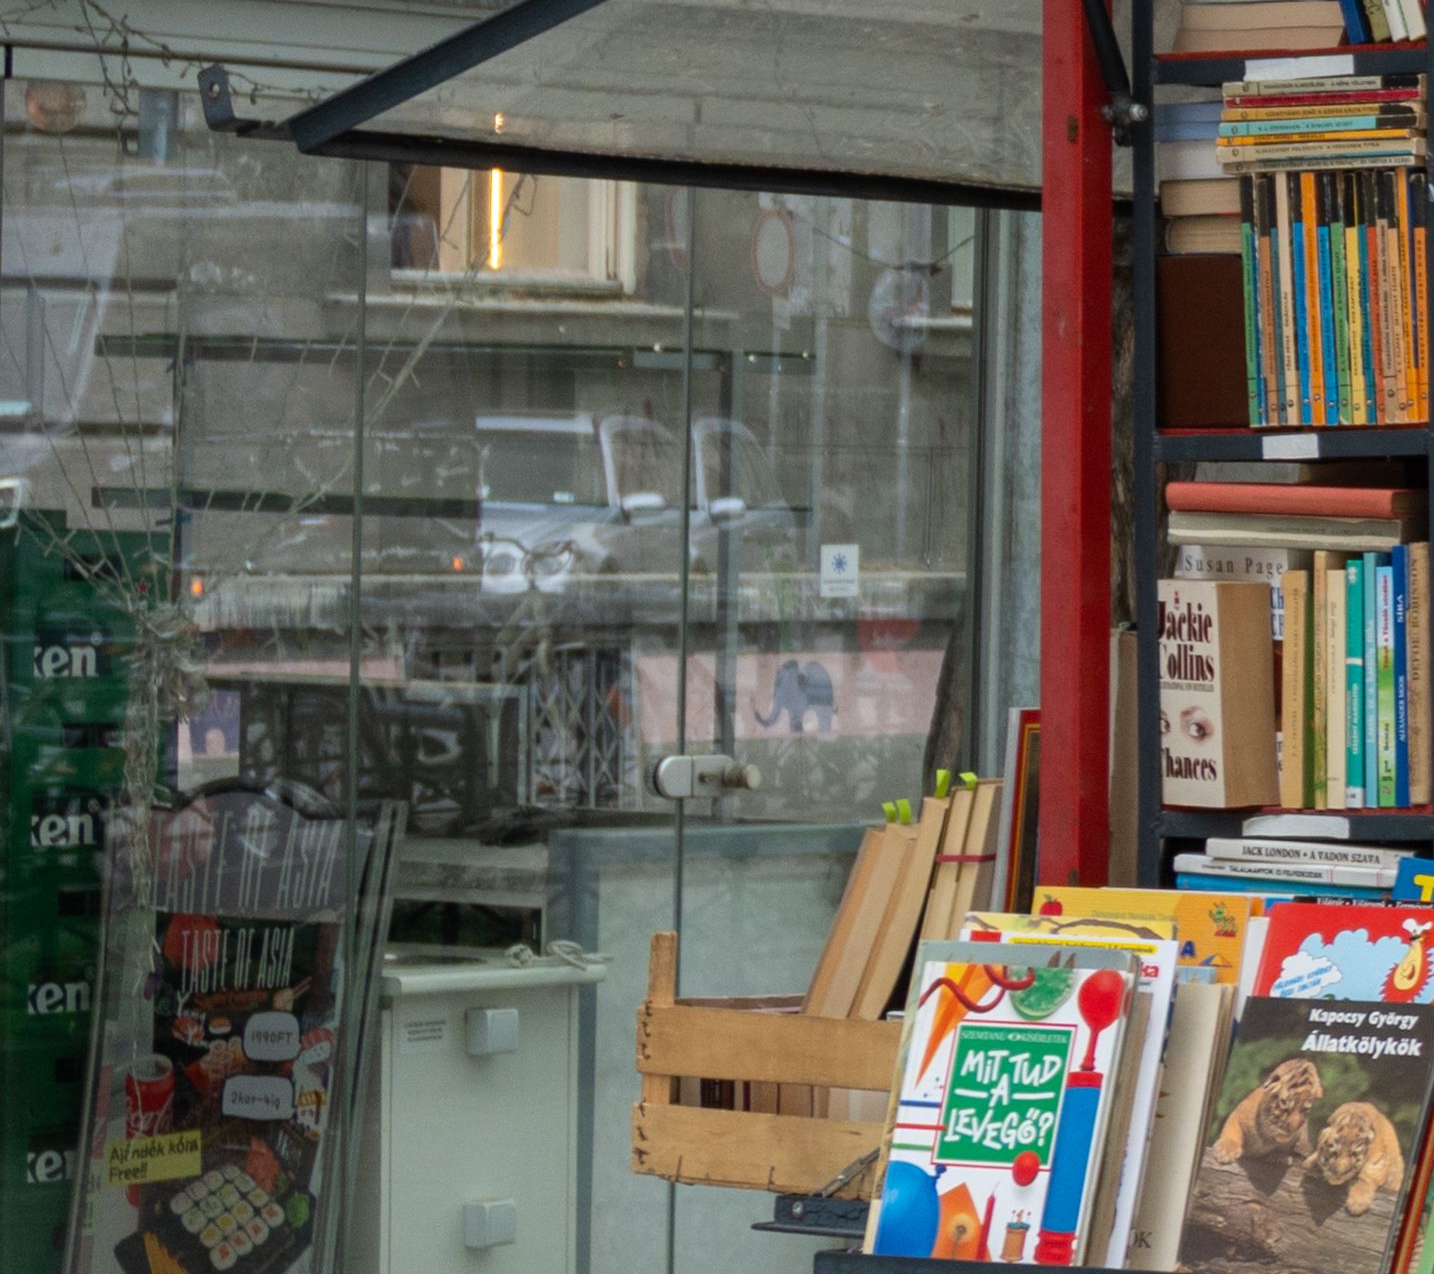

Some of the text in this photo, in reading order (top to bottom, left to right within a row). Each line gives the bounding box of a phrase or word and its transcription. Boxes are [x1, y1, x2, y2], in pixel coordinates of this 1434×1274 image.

[1184, 554, 1284, 580] Susan Page
[1158, 601, 1213, 643] Jackie
[1242, 846, 1263, 858] JACK
[1264, 847, 1301, 860] LONDON
[1318, 851, 1351, 863] VADON
[1351, 853, 1381, 865] SZAVA
[181, 927, 295, 993] TASTE OF ASIA
[1309, 1008, 1419, 1031] Kapocsy György
[1301, 1031, 1421, 1057] Állatkölykök
[989, 1074, 1009, 1107] A
[944, 1108, 1054, 1149] LEVEGŐ?
